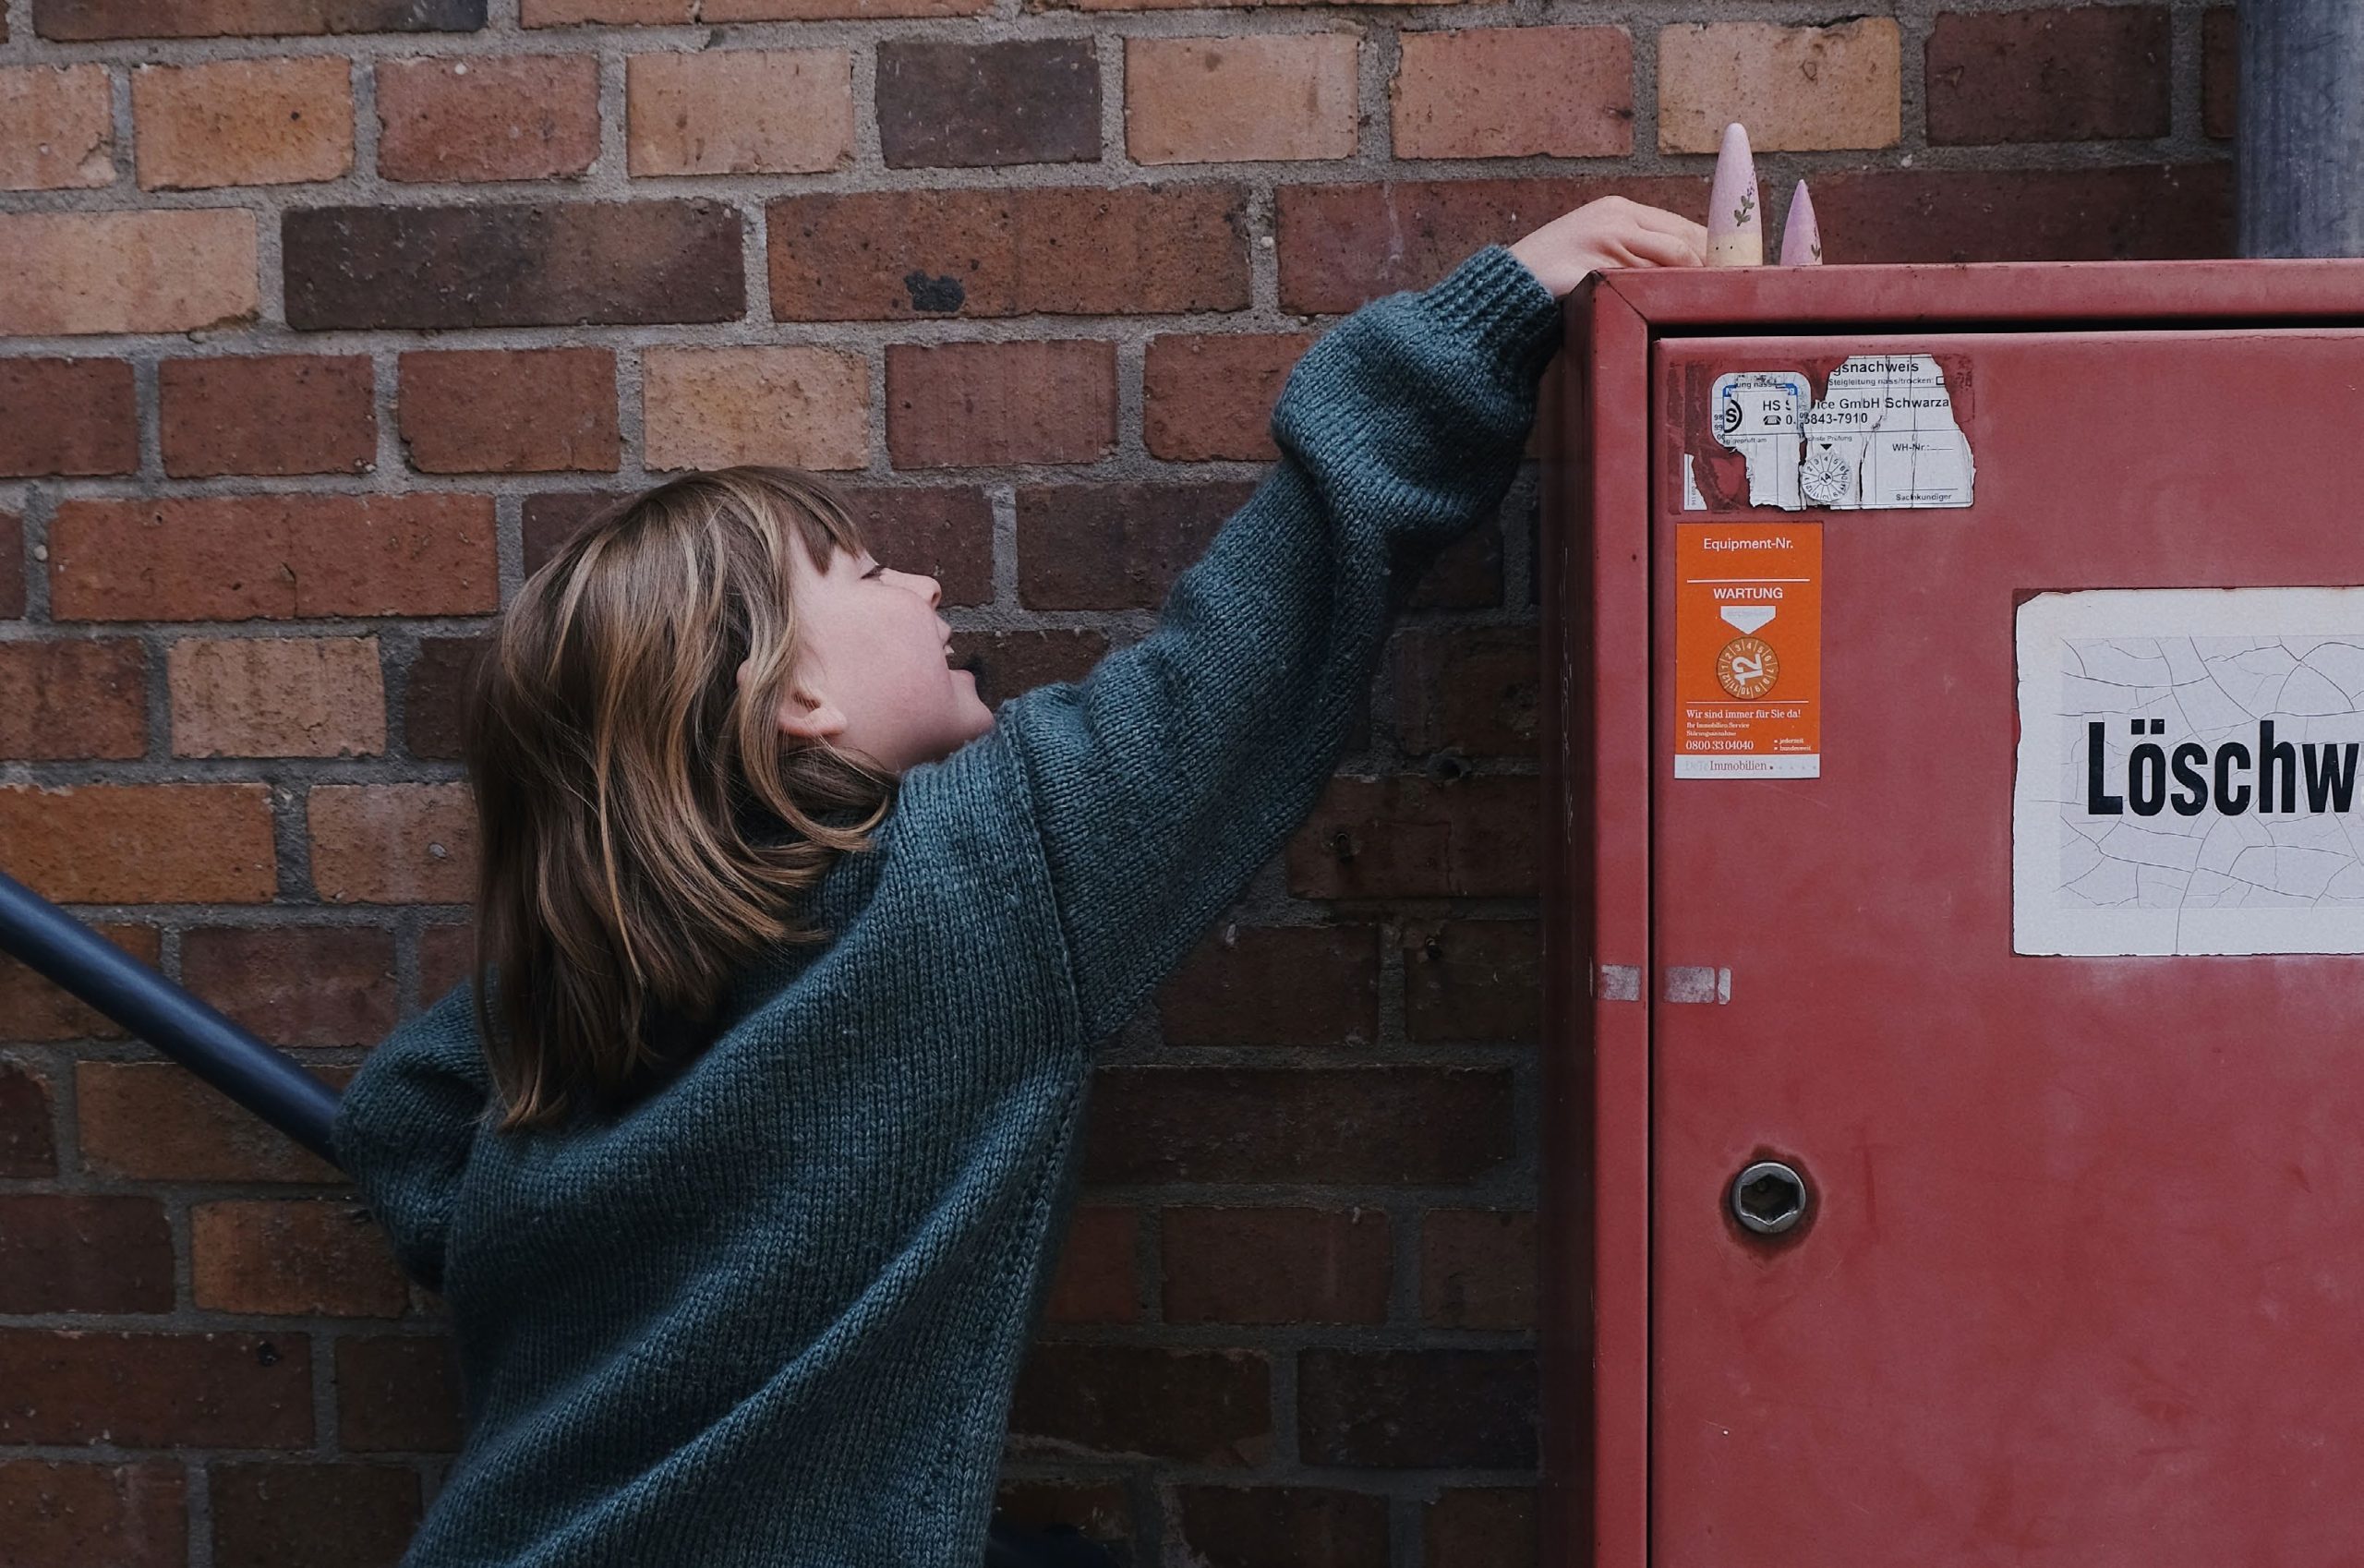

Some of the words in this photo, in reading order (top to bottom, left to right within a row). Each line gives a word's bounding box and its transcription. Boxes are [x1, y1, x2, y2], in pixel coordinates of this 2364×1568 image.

[1763, 400, 1780, 411] HS
[1839, 397, 1880, 409] GmbH
[1885, 397, 1949, 408] Schwarza
[1704, 537, 1794, 551] Equipment-Nr.
[1713, 587, 1783, 599] WARTUNG
[1732, 653, 1764, 686] 12
[1686, 709, 1703, 718] Wir
[1704, 709, 1723, 718] sind
[1724, 709, 1755, 718] immer
[1755, 708, 1769, 718] für
[1770, 709, 1785, 718] Sie
[1786, 709, 1801, 718] da!
[1685, 740, 1710, 750] 0800
[2088, 718, 2359, 816] Löschw
